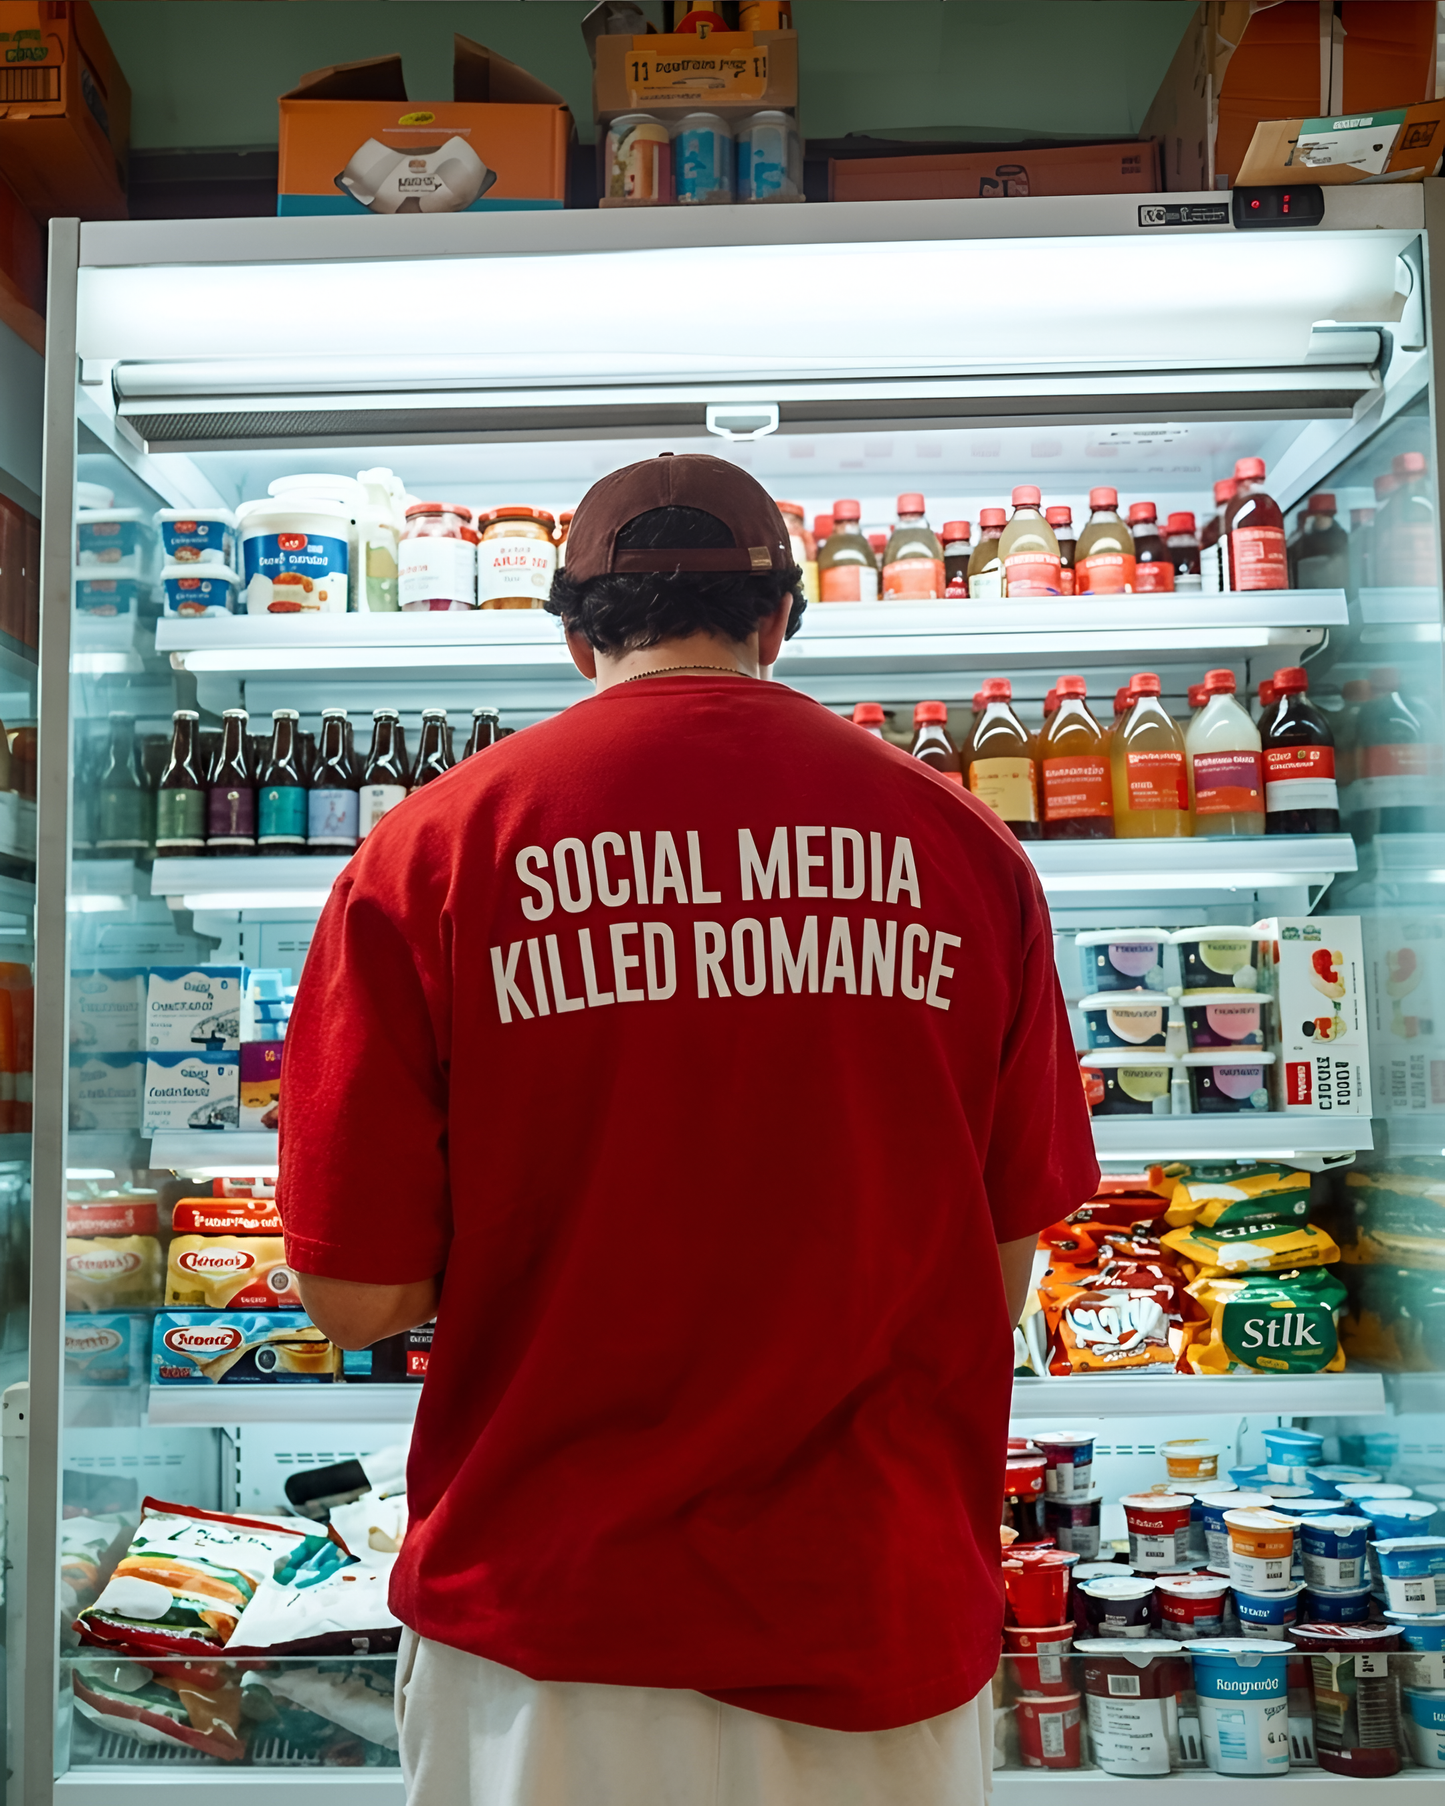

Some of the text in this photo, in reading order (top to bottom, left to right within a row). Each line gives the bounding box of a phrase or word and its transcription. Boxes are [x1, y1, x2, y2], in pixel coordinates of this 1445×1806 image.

[515, 825, 922, 922] SOCIAL MEDIA
[489, 914, 962, 1024] KILLED ROMANCE
[1241, 1312, 1322, 1349] Stlk
